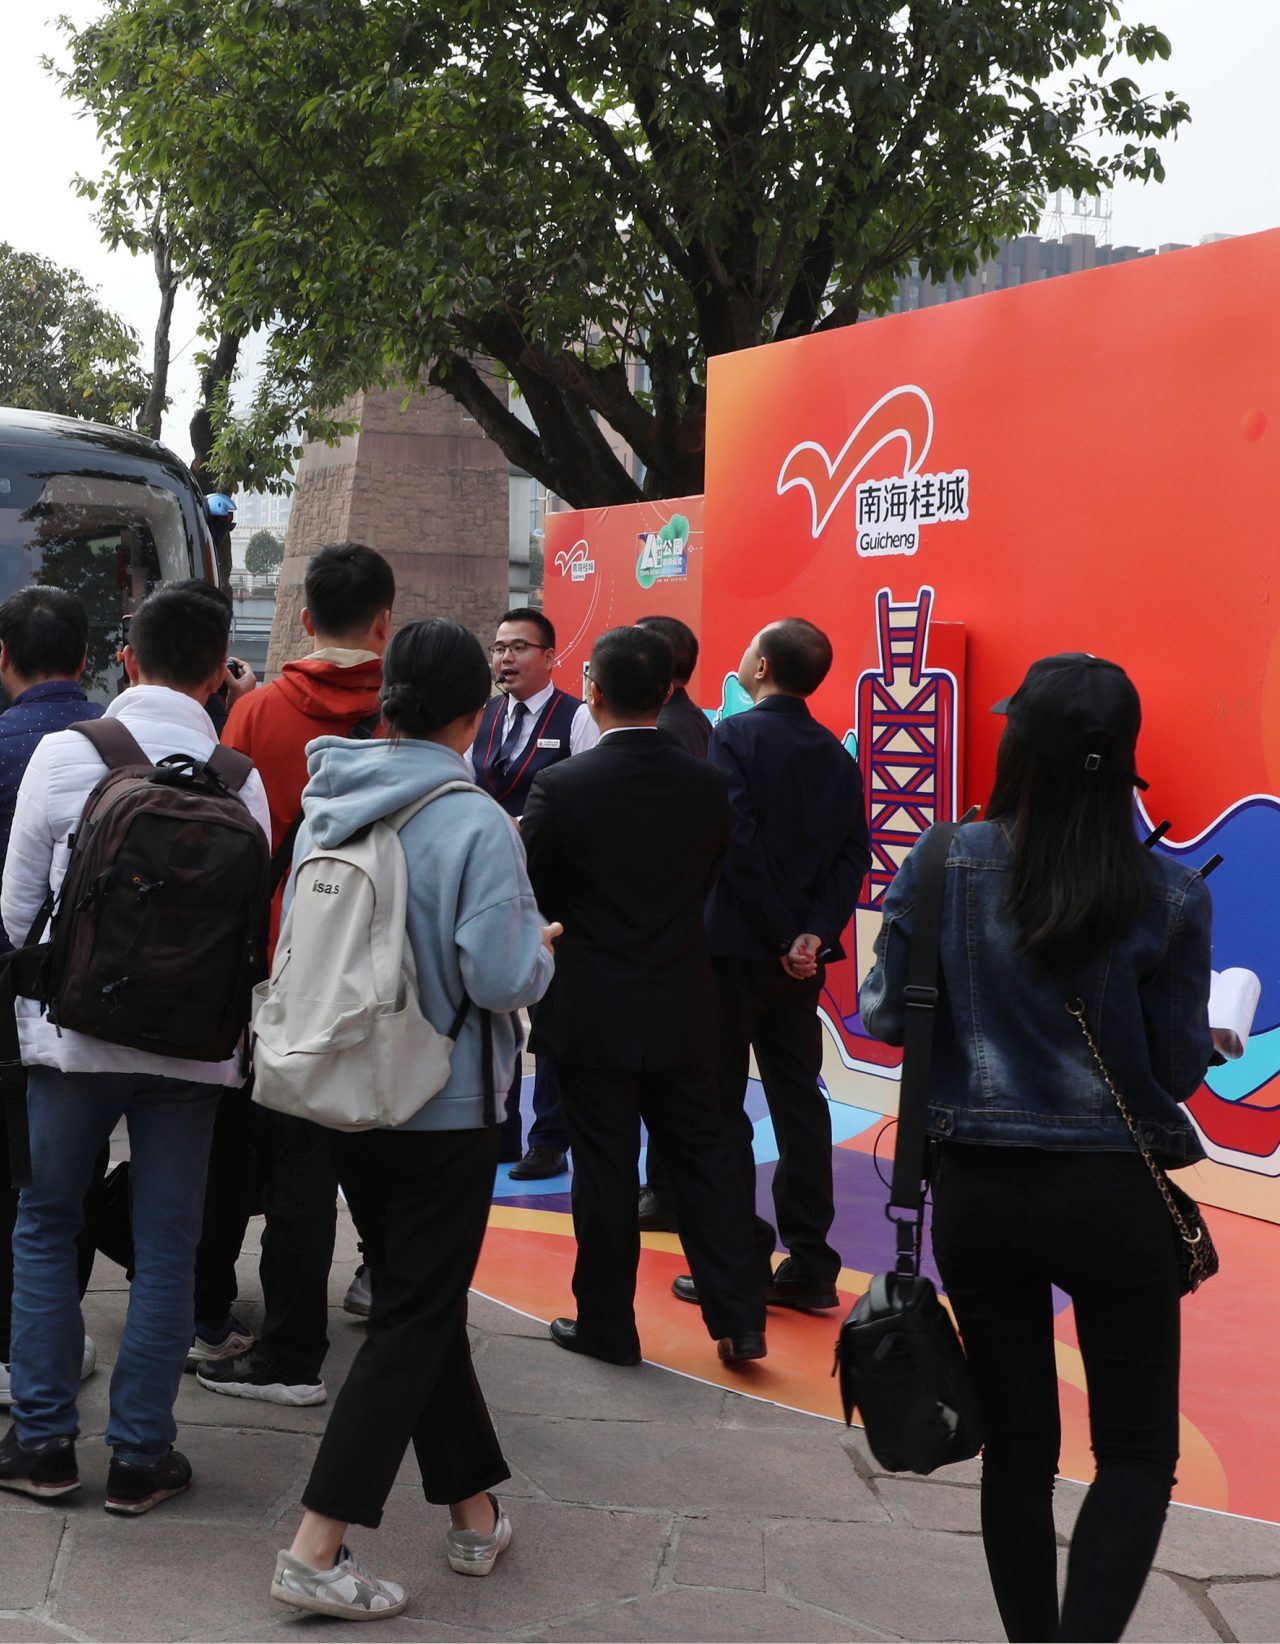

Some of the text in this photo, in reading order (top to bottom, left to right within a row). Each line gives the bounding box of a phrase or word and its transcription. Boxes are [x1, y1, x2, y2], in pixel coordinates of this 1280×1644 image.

[859, 476, 966, 526] 南海桂城
[860, 531, 916, 551] Guicheng
